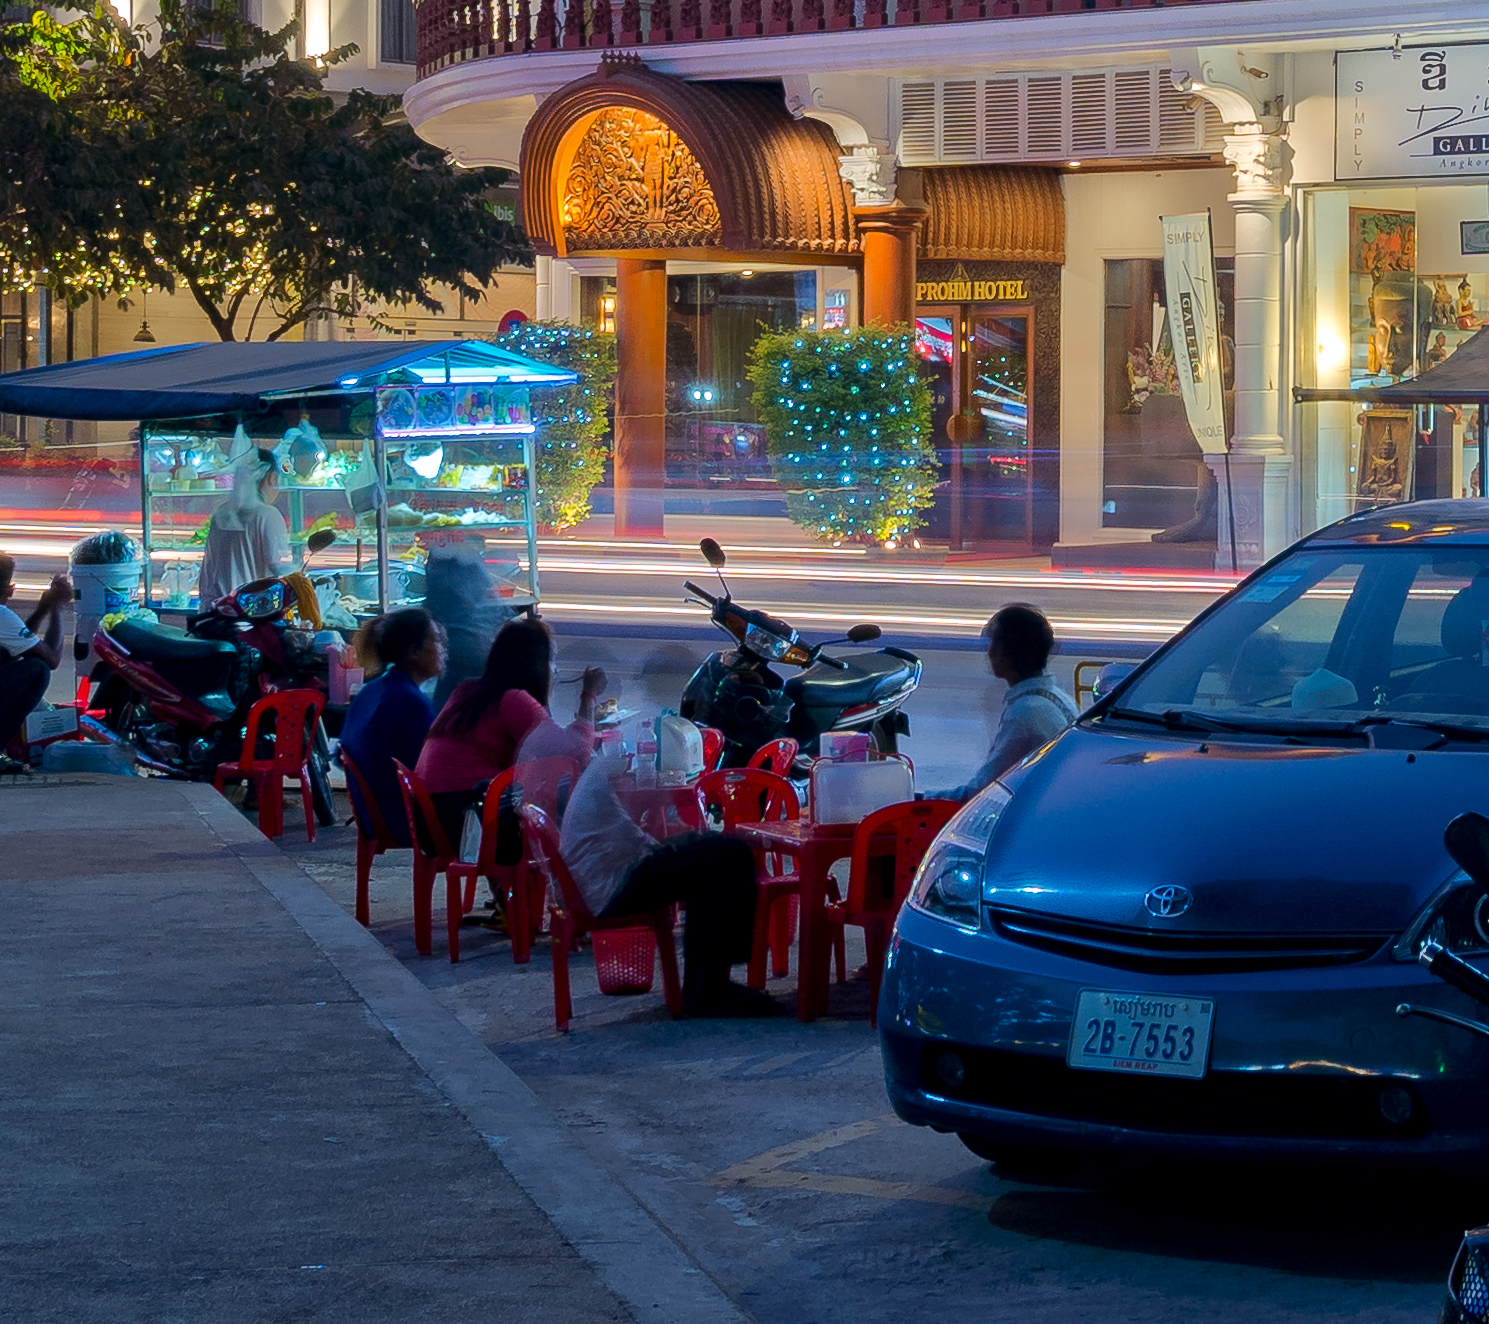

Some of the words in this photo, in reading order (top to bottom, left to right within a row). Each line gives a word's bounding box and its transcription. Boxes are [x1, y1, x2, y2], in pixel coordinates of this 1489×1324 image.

[1167, 230, 1205, 245] SIMPLY
[916, 281, 972, 301] PROHM
[974, 280, 1028, 300] HOTEL
[1083, 1018, 1195, 1061] 2B-7553
[1113, 1060, 1132, 1069] SIEM
[1135, 1062, 1158, 1070] REAP
